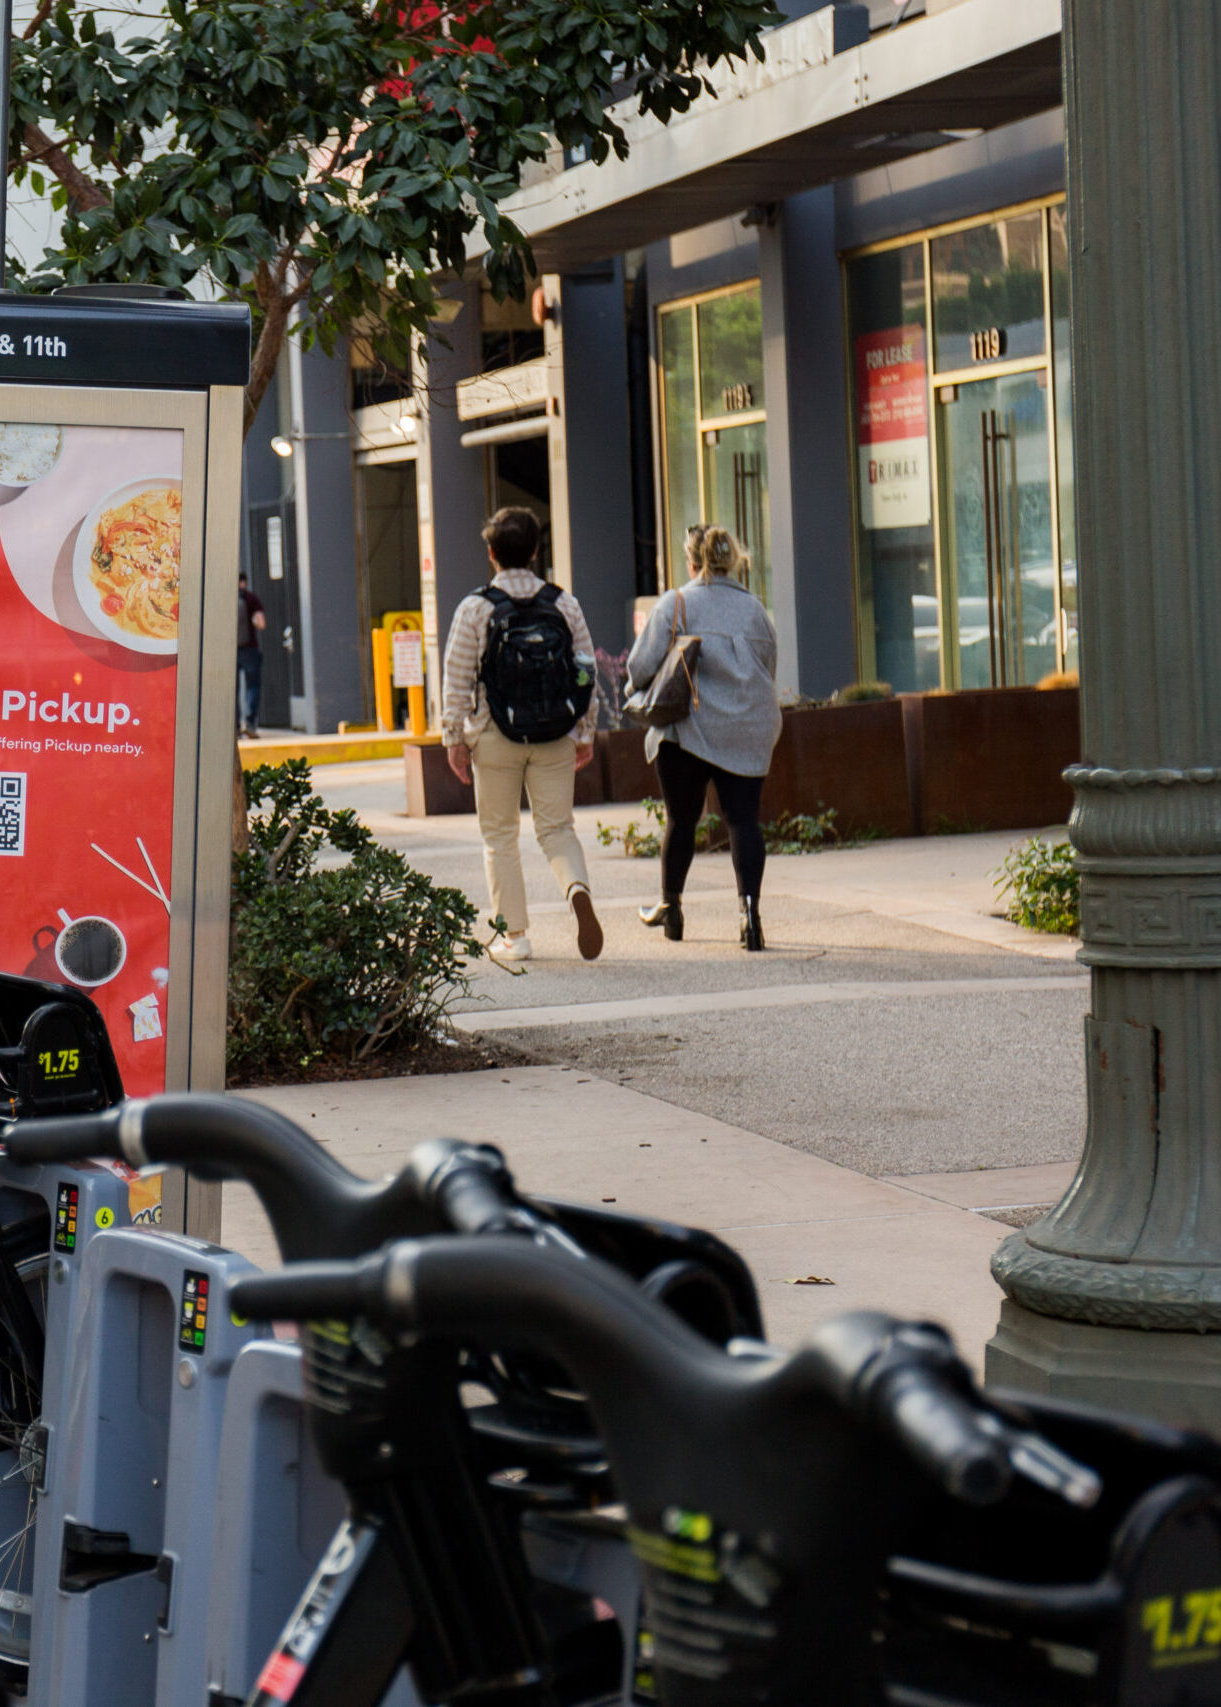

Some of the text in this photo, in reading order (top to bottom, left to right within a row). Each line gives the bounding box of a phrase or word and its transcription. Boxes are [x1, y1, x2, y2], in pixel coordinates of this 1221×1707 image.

[22, 334, 67, 357] 11th
[969, 326, 1000, 362] 1119
[866, 344, 913, 371] FOR LEASE
[1, 689, 141, 734] Pickup.
[44, 738, 92, 755] Pickup
[94, 742, 145, 758] nearby.
[38, 1048, 80, 1074] $1.75
[100, 1210, 110, 1225] 6
